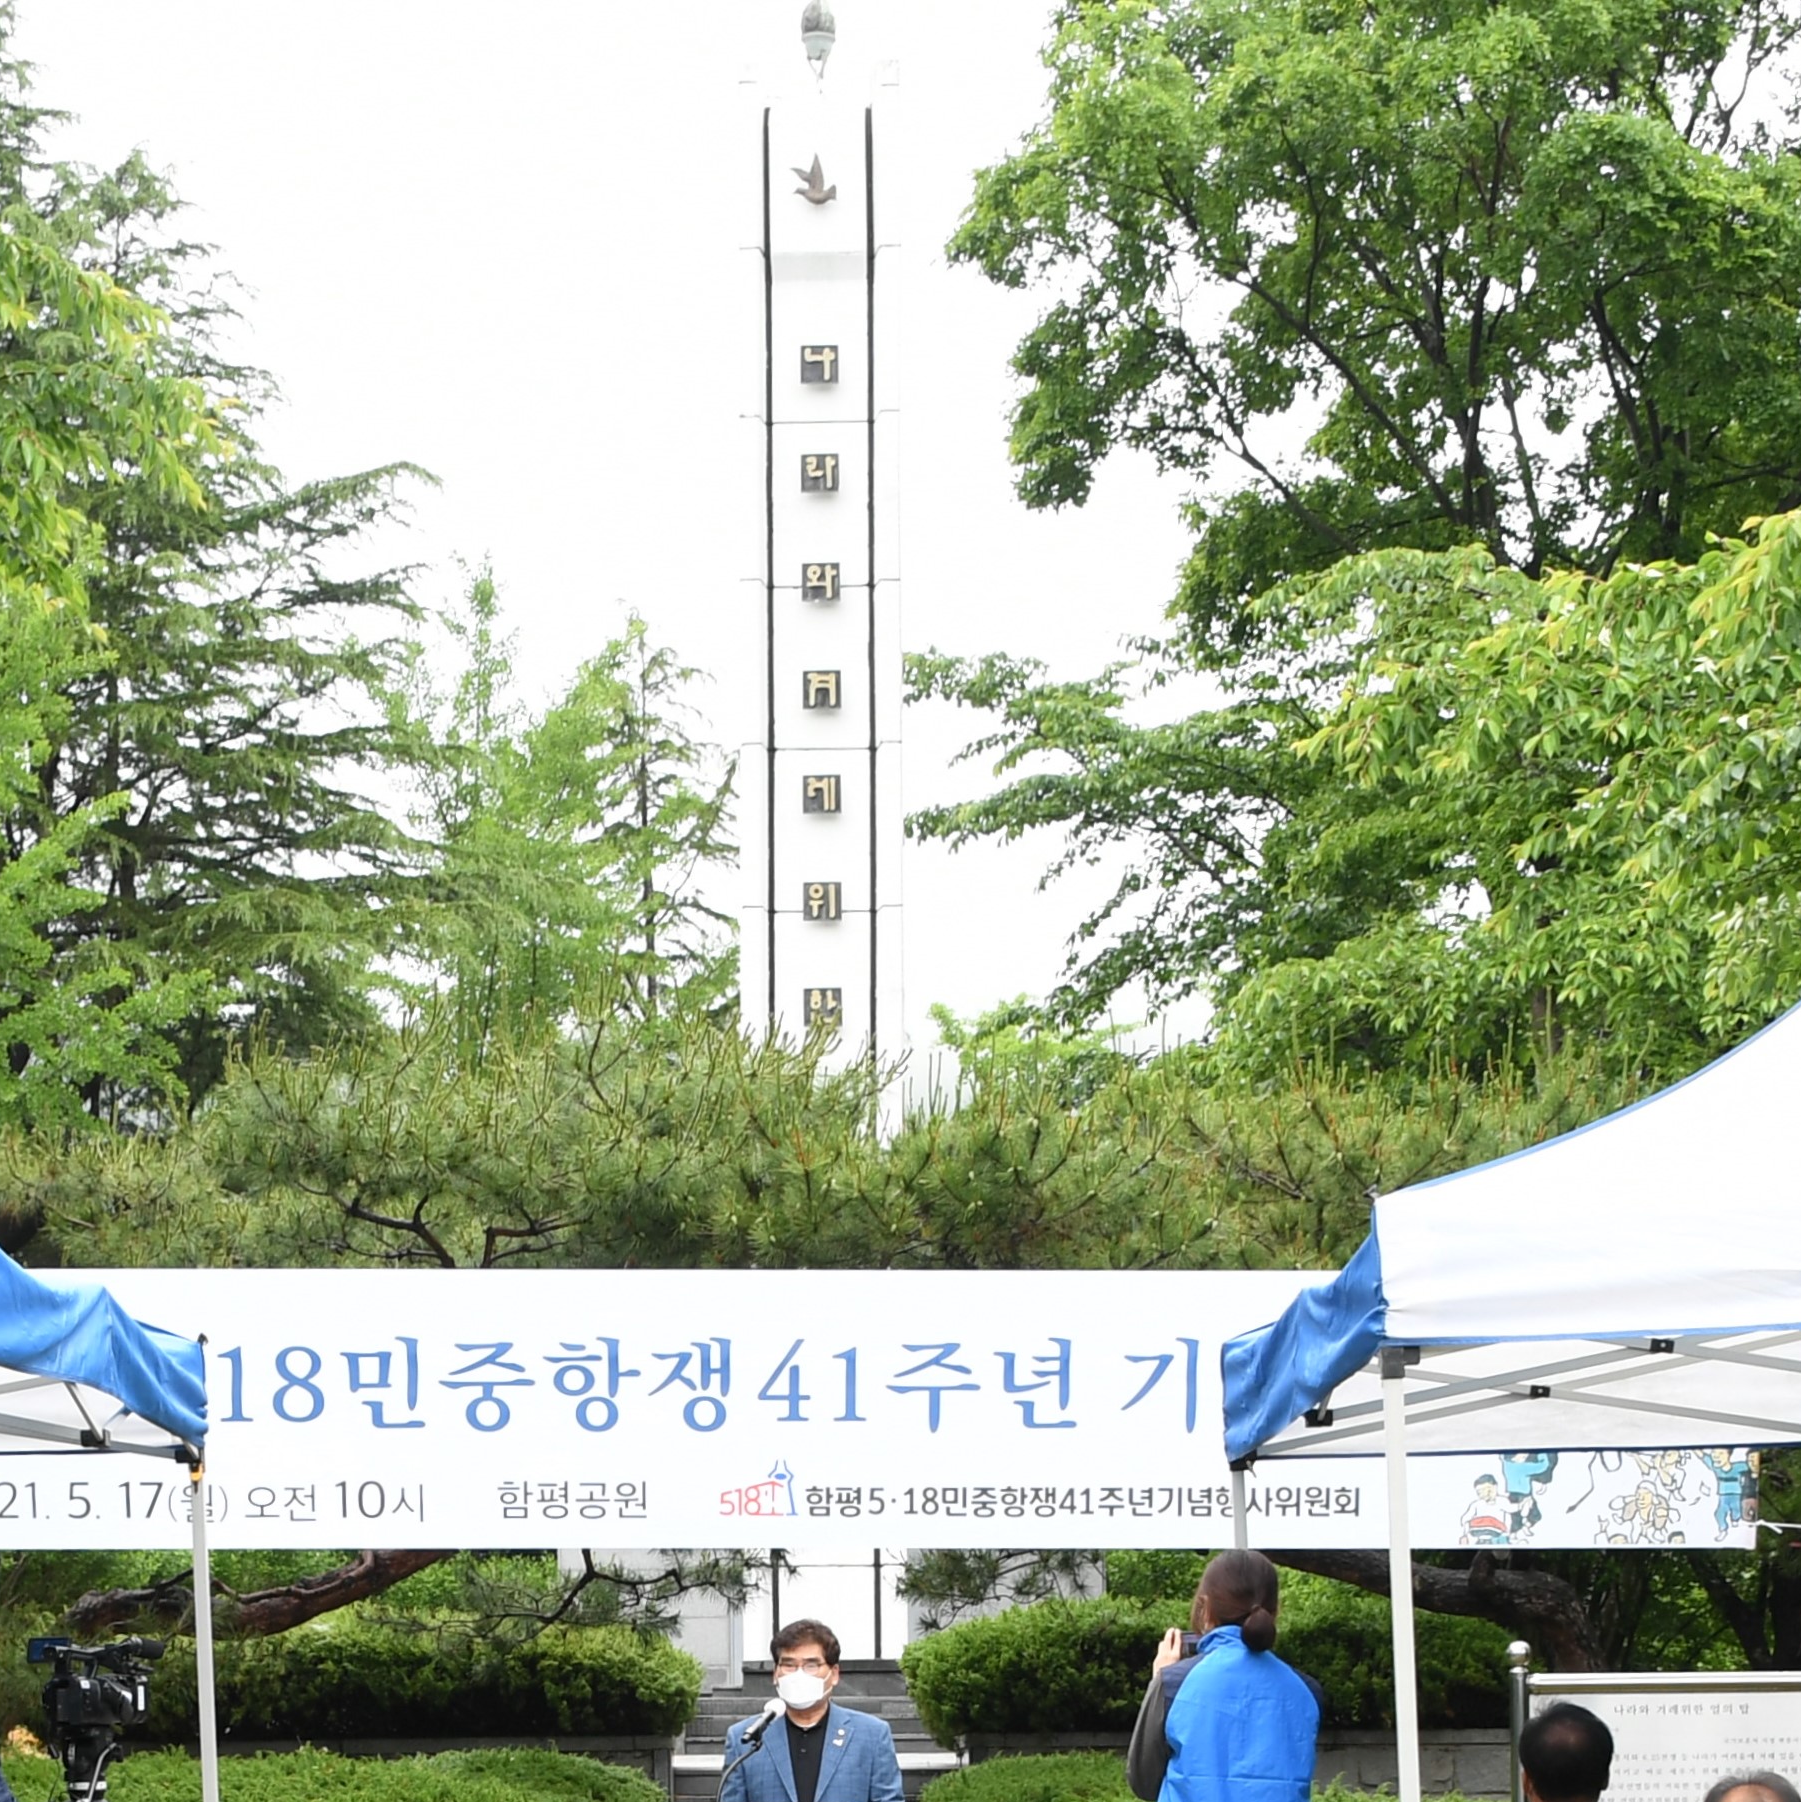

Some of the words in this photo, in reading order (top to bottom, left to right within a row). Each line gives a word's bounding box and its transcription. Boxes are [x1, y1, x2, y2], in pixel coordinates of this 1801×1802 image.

[244, 1484, 318, 1522] 오전
[335, 1481, 426, 1522] 10시
[497, 1480, 648, 1520] 함평공원
[1614, 1704, 1650, 1716] 나라와
